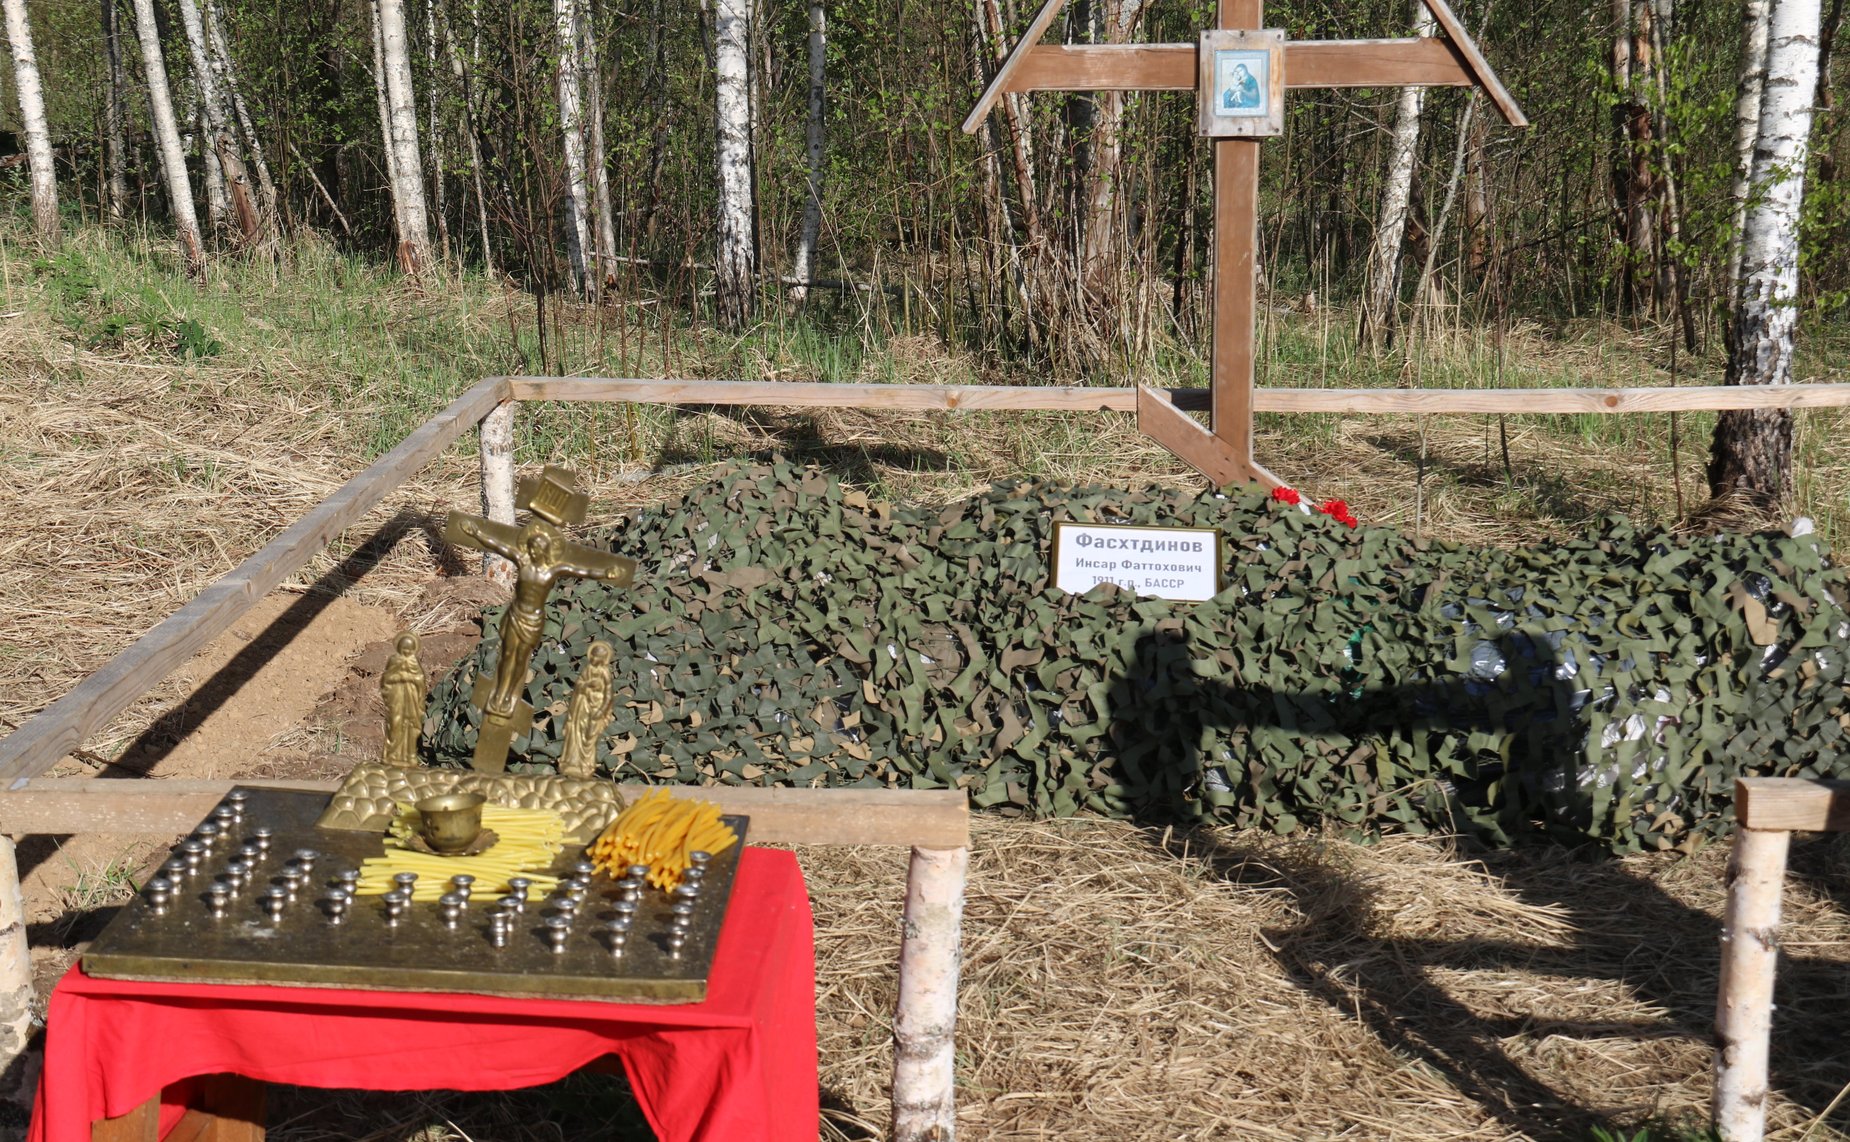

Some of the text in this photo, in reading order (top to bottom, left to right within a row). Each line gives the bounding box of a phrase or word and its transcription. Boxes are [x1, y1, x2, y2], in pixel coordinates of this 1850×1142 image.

[1075, 532, 1203, 553] Фасхтдинов
[1075, 557, 1202, 574] Инсар Фаттохович
[1145, 577, 1185, 589] БАССР
